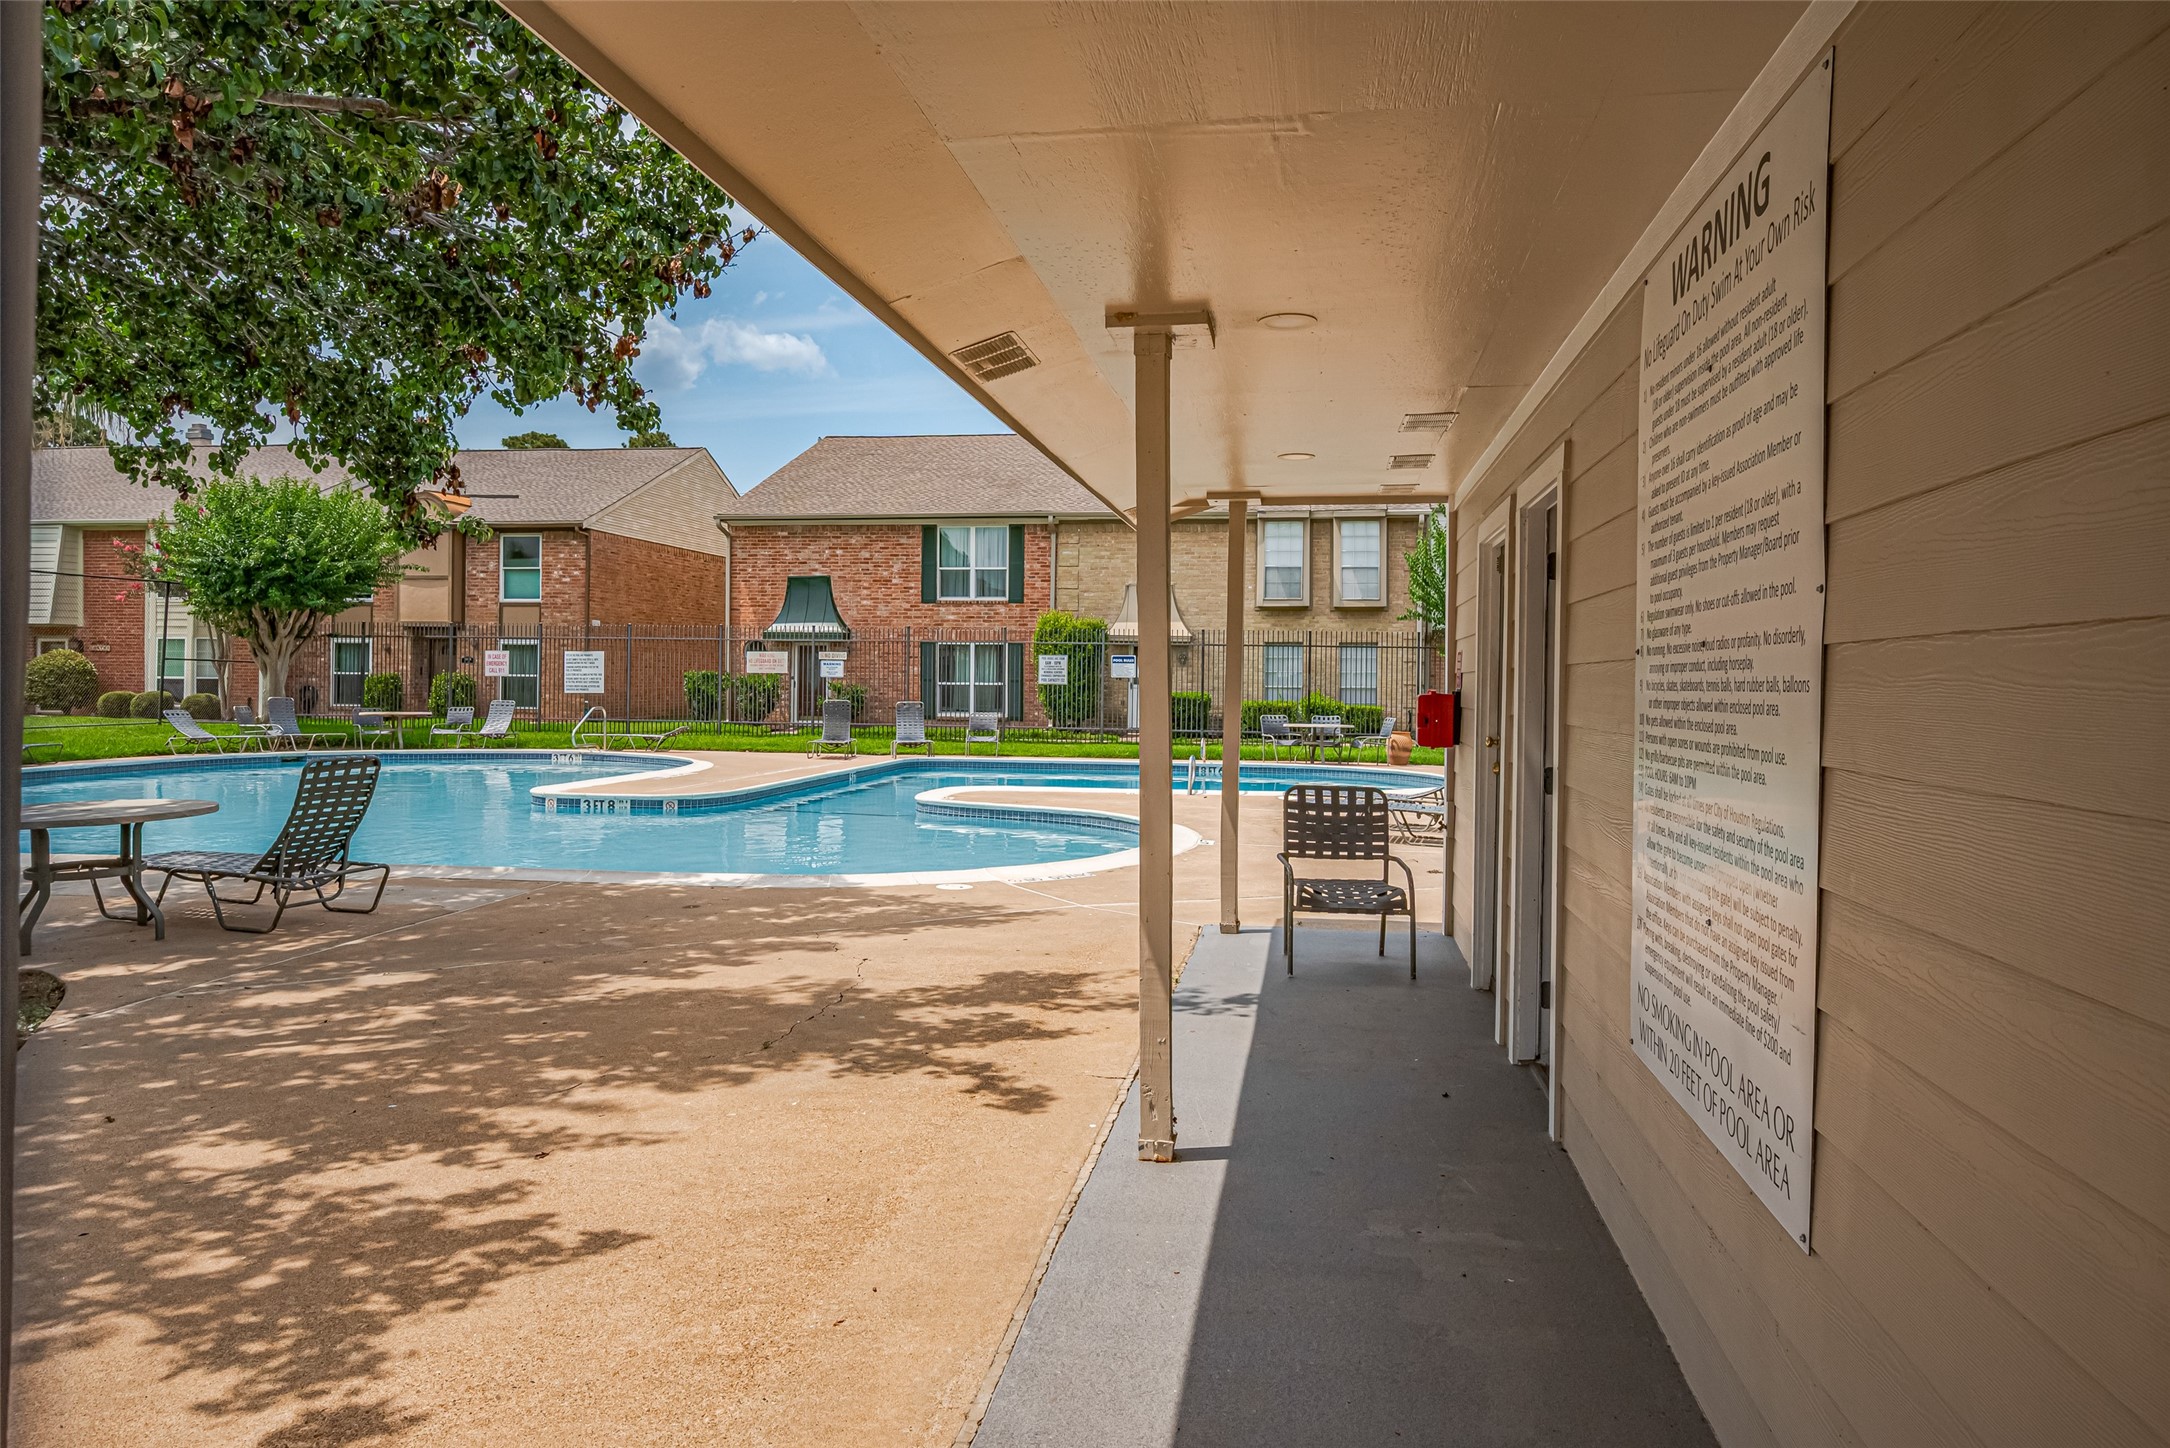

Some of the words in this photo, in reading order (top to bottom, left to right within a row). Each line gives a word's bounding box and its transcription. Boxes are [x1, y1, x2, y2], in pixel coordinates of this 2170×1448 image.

[1671, 150, 1771, 307] WARNING
[1643, 346, 1652, 371] No
[1652, 313, 1680, 363] Lifeguard
[1680, 308, 1691, 337] On
[1692, 290, 1709, 327] Duty
[1710, 269, 1732, 309] Swim
[1732, 252, 1743, 288] At
[1744, 236, 1765, 277] Your
[1766, 211, 1790, 256] Own
[1792, 176, 1816, 231] Risk
[1738, 290, 1761, 322] resident
[1760, 276, 1776, 303] adult
[1743, 320, 1751, 340] All
[1750, 290, 1787, 333] non-resident
[1752, 330, 1767, 355] adult
[1767, 321, 1778, 347] (18
[1786, 297, 1808, 329] older).
[1750, 354, 1763, 378] with
[1763, 333, 1792, 370] approved
[1793, 327, 1804, 348] life
[1752, 405, 1762, 423] age
[1762, 393, 1774, 415] and
[1775, 389, 1788, 408] may
[1735, 448, 1766, 475] Association
[1766, 434, 1793, 459] Member
[1743, 496, 1753, 518] (18
[1760, 485, 1780, 508] older),
[1781, 478, 1795, 500] with
[1757, 509, 1779, 533] request
[1738, 531, 1782, 560] Manager/Board
[1783, 528, 1799, 550] prior
[1740, 584, 1761, 604] allowed
[1768, 581, 1779, 598] the
[1780, 576, 1796, 599] pool.
[1736, 631, 1762, 651] profanity.
[1772, 625, 1805, 645] disorderly,
[1728, 654, 1754, 672] horseplay.
[1733, 676, 1746, 691] hard
[1745, 676, 1765, 692] rubber
[1765, 675, 1781, 694] balls,
[1782, 675, 1810, 692] balloons
[1728, 698, 1752, 714] enclosed
[1751, 699, 1765, 718] pool
[1765, 704, 1781, 716] area.
[1746, 743, 1760, 760] from
[1760, 747, 1774, 765] pool
[1774, 752, 1787, 765] use.
[1740, 767, 1752, 784] pool
[1752, 771, 1767, 786] area.
[1735, 834, 1756, 855] security
[1763, 841, 1774, 859] the
[1774, 847, 1788, 864] pool
[1789, 853, 1804, 870] area
[1733, 852, 1750, 872] within
[1750, 858, 1760, 877] the
[1760, 865, 1773, 882] pool
[1773, 872, 1788, 889] area
[1788, 875, 1803, 896] who
[1752, 883, 1778, 914] (whether
[1757, 935, 1770, 953] pool
[1770, 942, 1787, 963] gates
[1787, 947, 1797, 969] for
[1777, 922, 1803, 949] penalty.
[1727, 939, 1749, 963] assigned
[1749, 949, 1759, 973] key
[1759, 955, 1778, 982] issued
[1778, 967, 1794, 992] from
[1751, 974, 1779, 1007] Manager.
[1737, 987, 1746, 1008] the
[1746, 998, 1759, 1017] pool
[1759, 1006, 1780, 1034] safety/
[1744, 1015, 1756, 1038] fine
[1762, 1030, 1778, 1056] $200
[1778, 1045, 1791, 1067] and
[1637, 980, 1649, 1013] NO
[1650, 992, 1691, 1053] SMOKING
[1692, 1027, 1703, 1062] IN
[1704, 1039, 1735, 1093] POOL
[1737, 1069, 1771, 1129] AREA
[1772, 1101, 1795, 1152] OR
[1639, 1016, 1668, 1068] WITHIN
[1668, 1046, 1679, 1081] 20
[1679, 1056, 1702, 1104] FEET
[1703, 1080, 1718, 1121] OF
[1719, 1097, 1752, 1158] POOL
[1754, 1133, 1791, 1200] AREA
